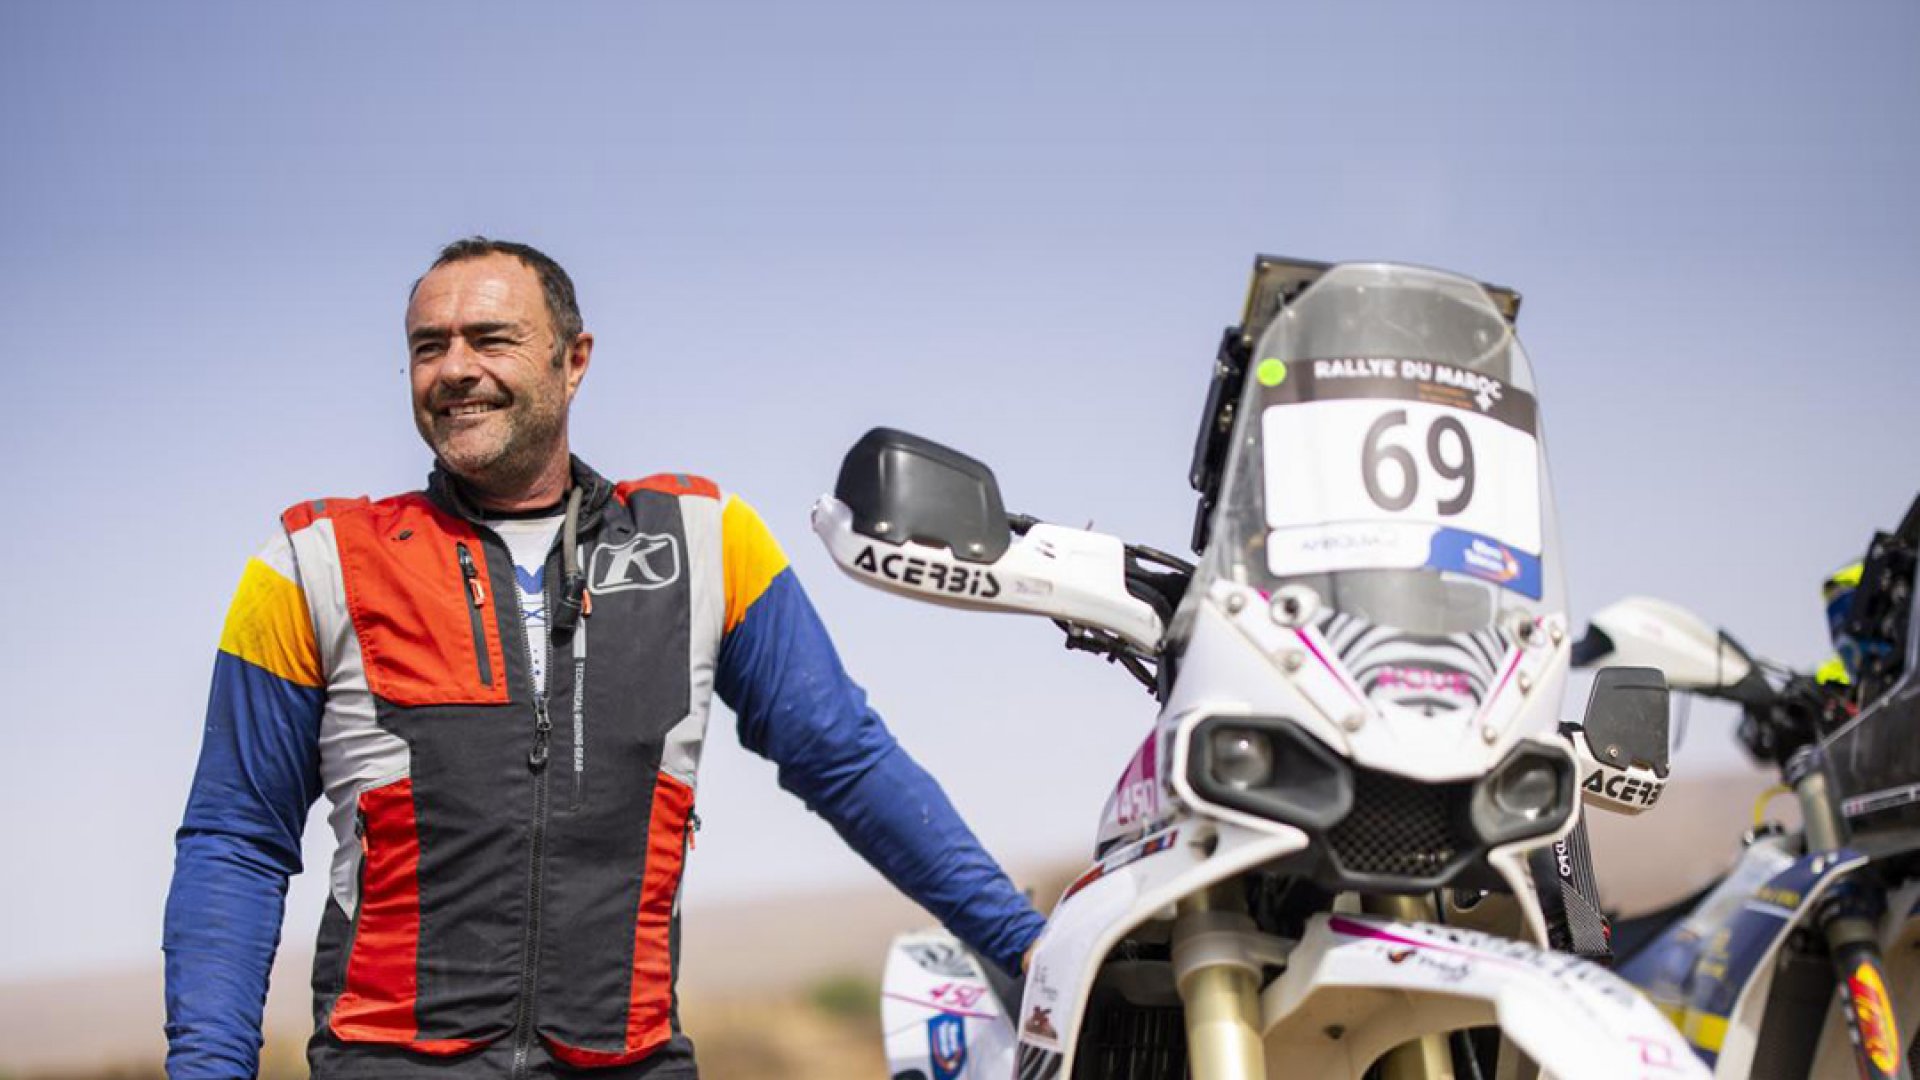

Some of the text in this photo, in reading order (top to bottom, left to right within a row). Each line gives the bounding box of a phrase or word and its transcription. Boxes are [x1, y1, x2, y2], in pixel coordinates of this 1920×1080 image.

[1314, 358, 1397, 379] RALLYE
[1401, 360, 1433, 381] DU
[1435, 364, 1503, 400] MAROC
[1361, 409, 1476, 516] 69
